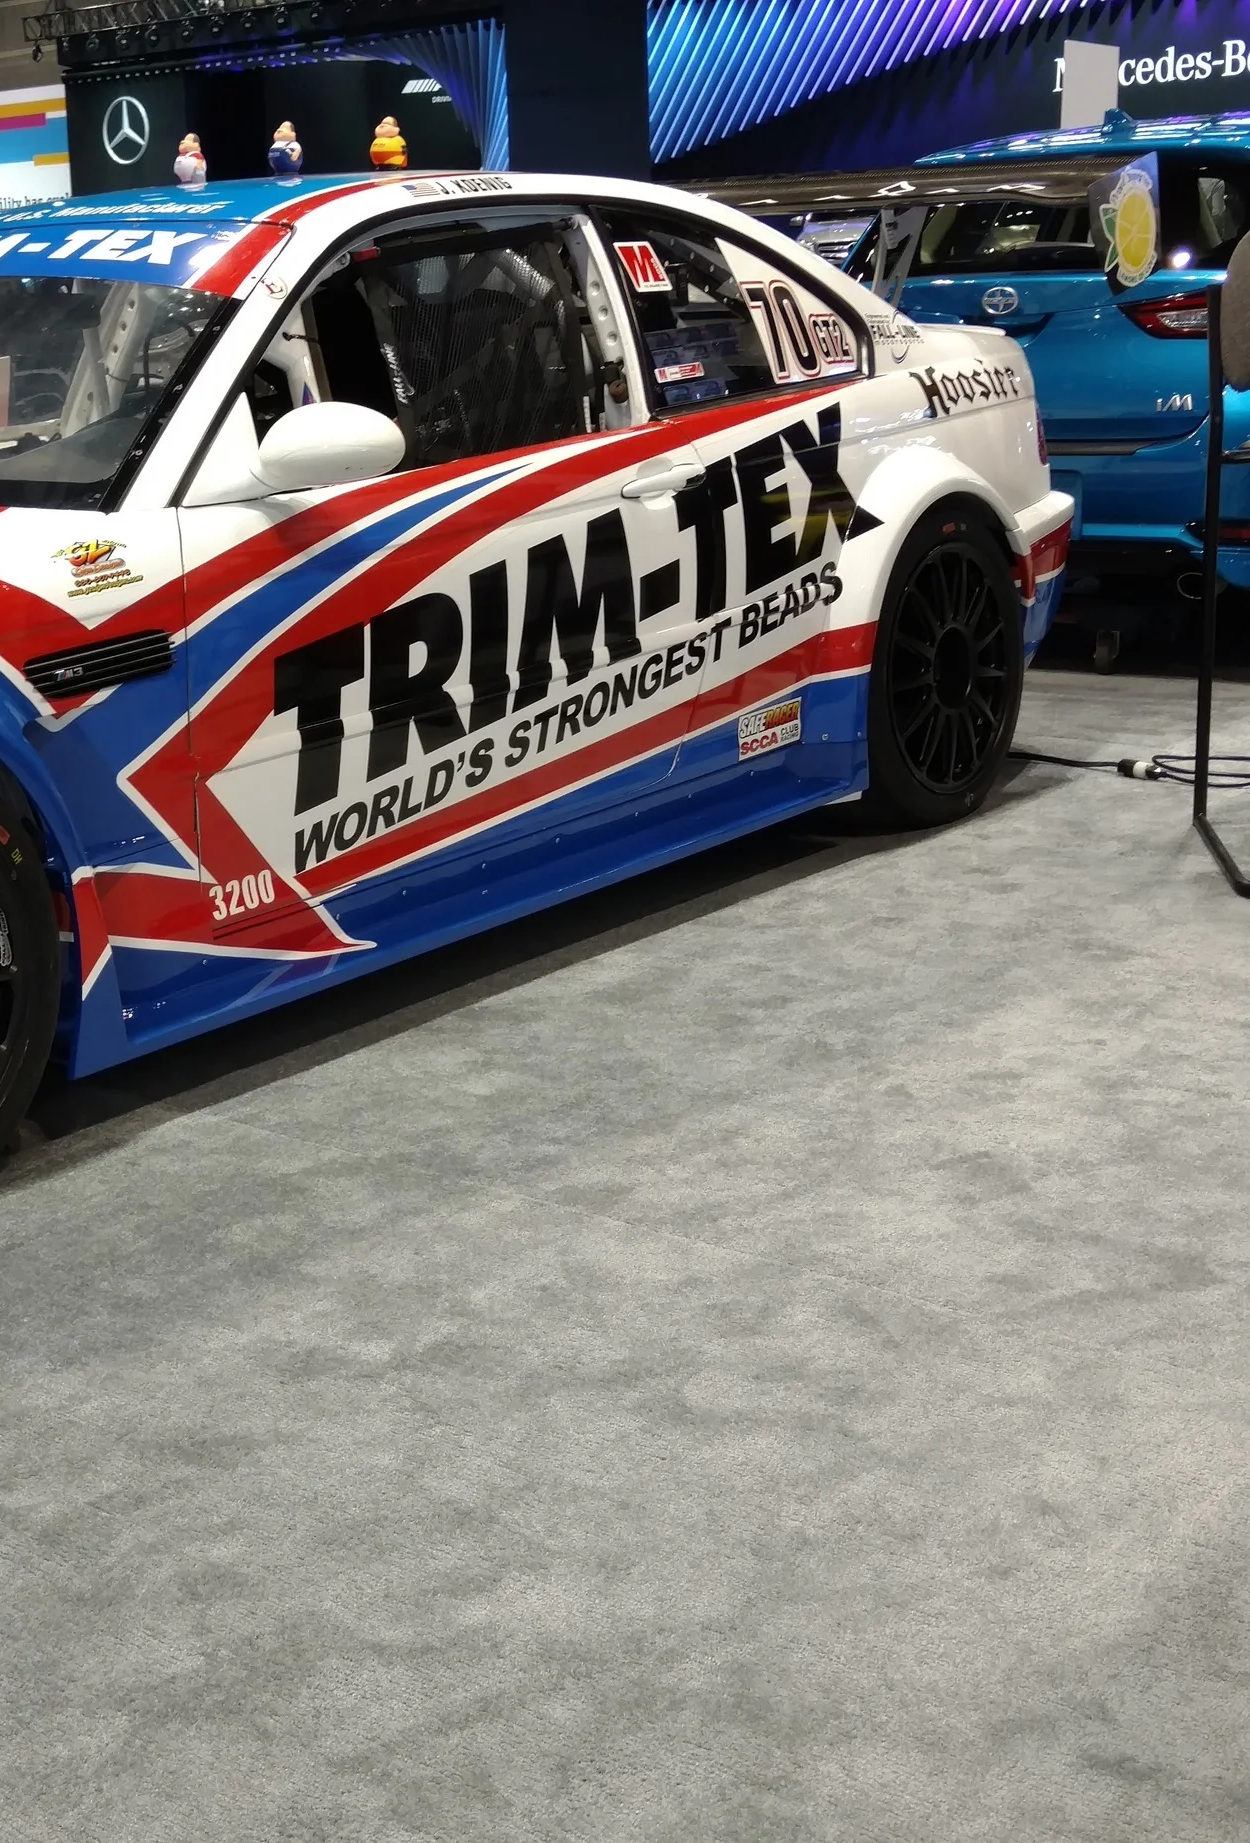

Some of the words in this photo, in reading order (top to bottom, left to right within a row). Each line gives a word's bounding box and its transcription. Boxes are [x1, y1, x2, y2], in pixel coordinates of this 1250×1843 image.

[1053, 39, 1250, 93] cedes-B
[48, 202, 228, 218] Manufacturer
[739, 279, 822, 380] 70
[808, 313, 855, 365] GT2
[908, 358, 1019, 418] Hoosier
[273, 402, 884, 817] TRIM-TEX
[294, 737, 494, 875] WORLD'S
[504, 617, 732, 768] STRONGEST
[739, 561, 843, 649] BEADS
[740, 731, 779, 756] SCCA
[780, 731, 799, 742] RACING
[780, 723, 799, 736] CLUB
[208, 869, 276, 921] 3200
